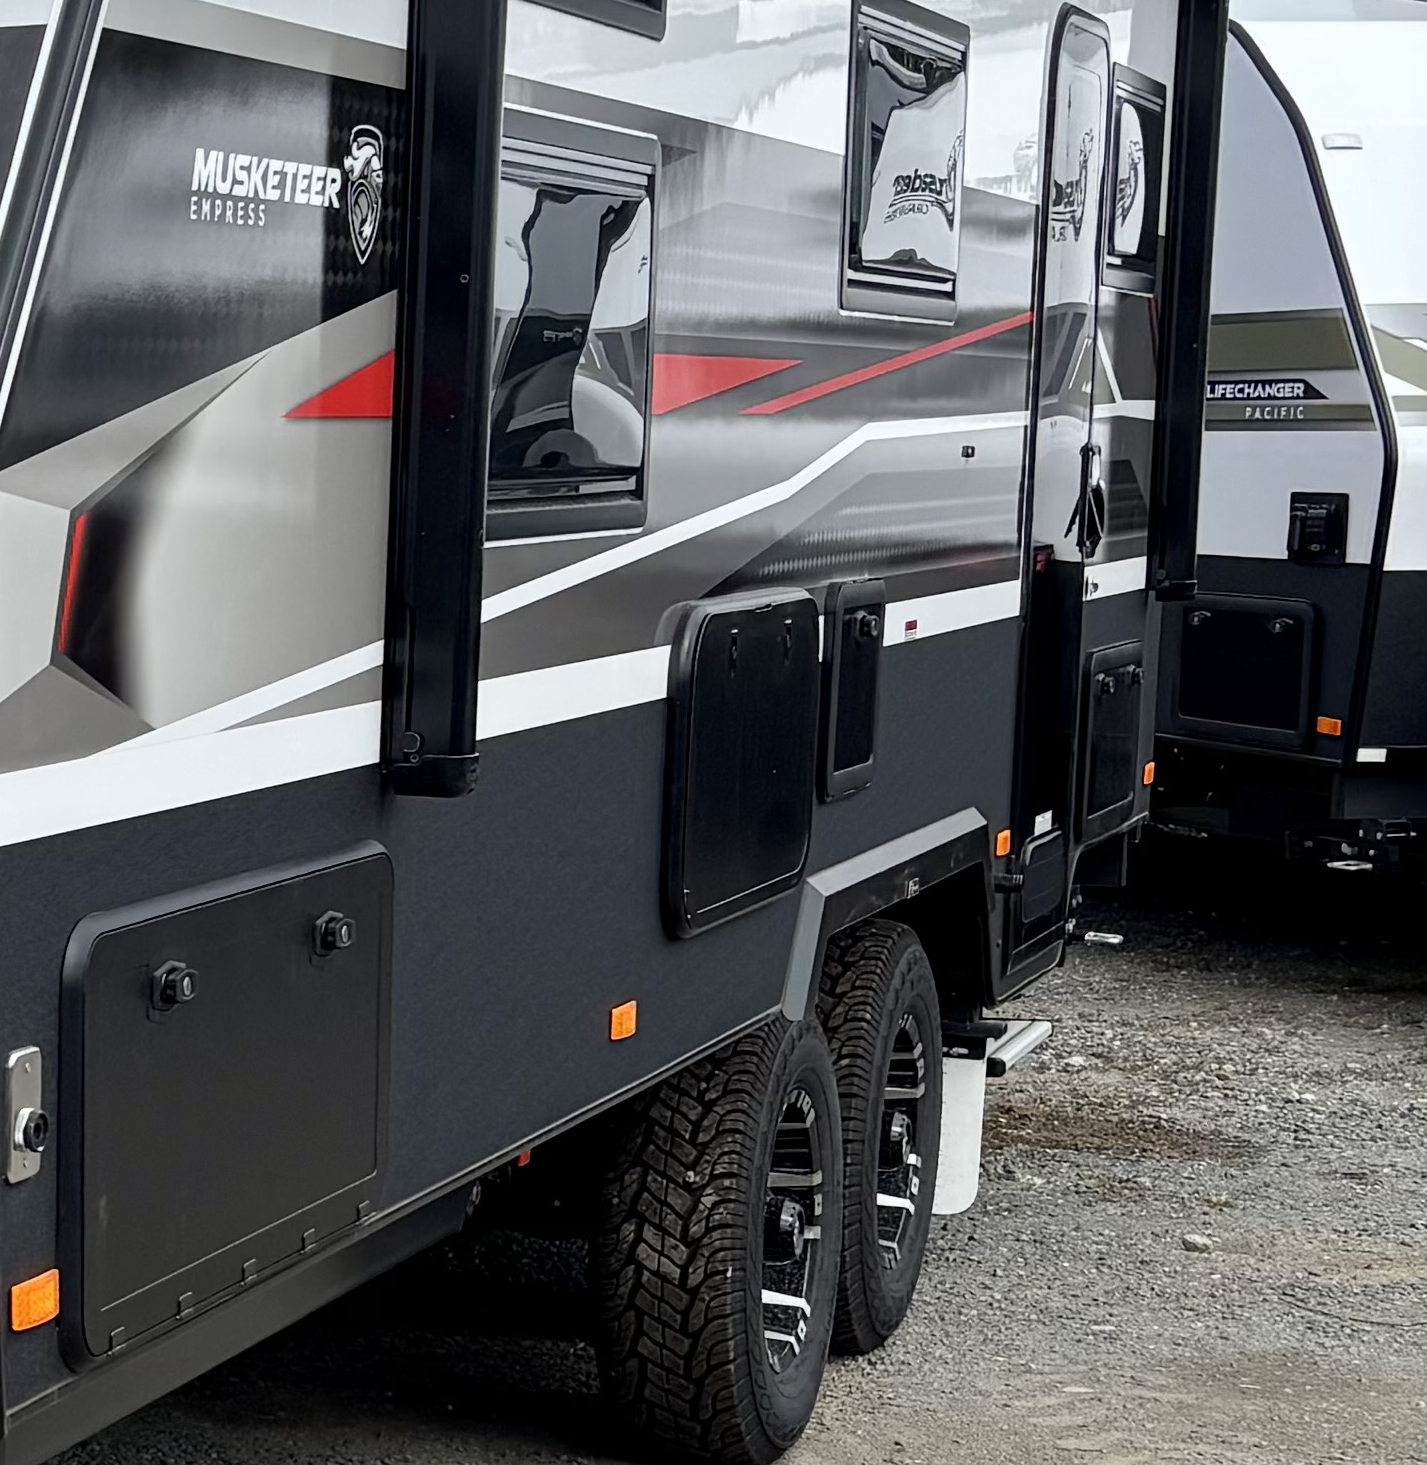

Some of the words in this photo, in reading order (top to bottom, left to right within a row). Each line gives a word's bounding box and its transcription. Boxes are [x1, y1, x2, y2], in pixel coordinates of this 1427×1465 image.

[190, 147, 343, 210] MUSKETEER
[189, 195, 266, 227] EMPRESS
[1206, 382, 1305, 399] LIFECHANGER
[1244, 405, 1305, 420] PACIFIC
